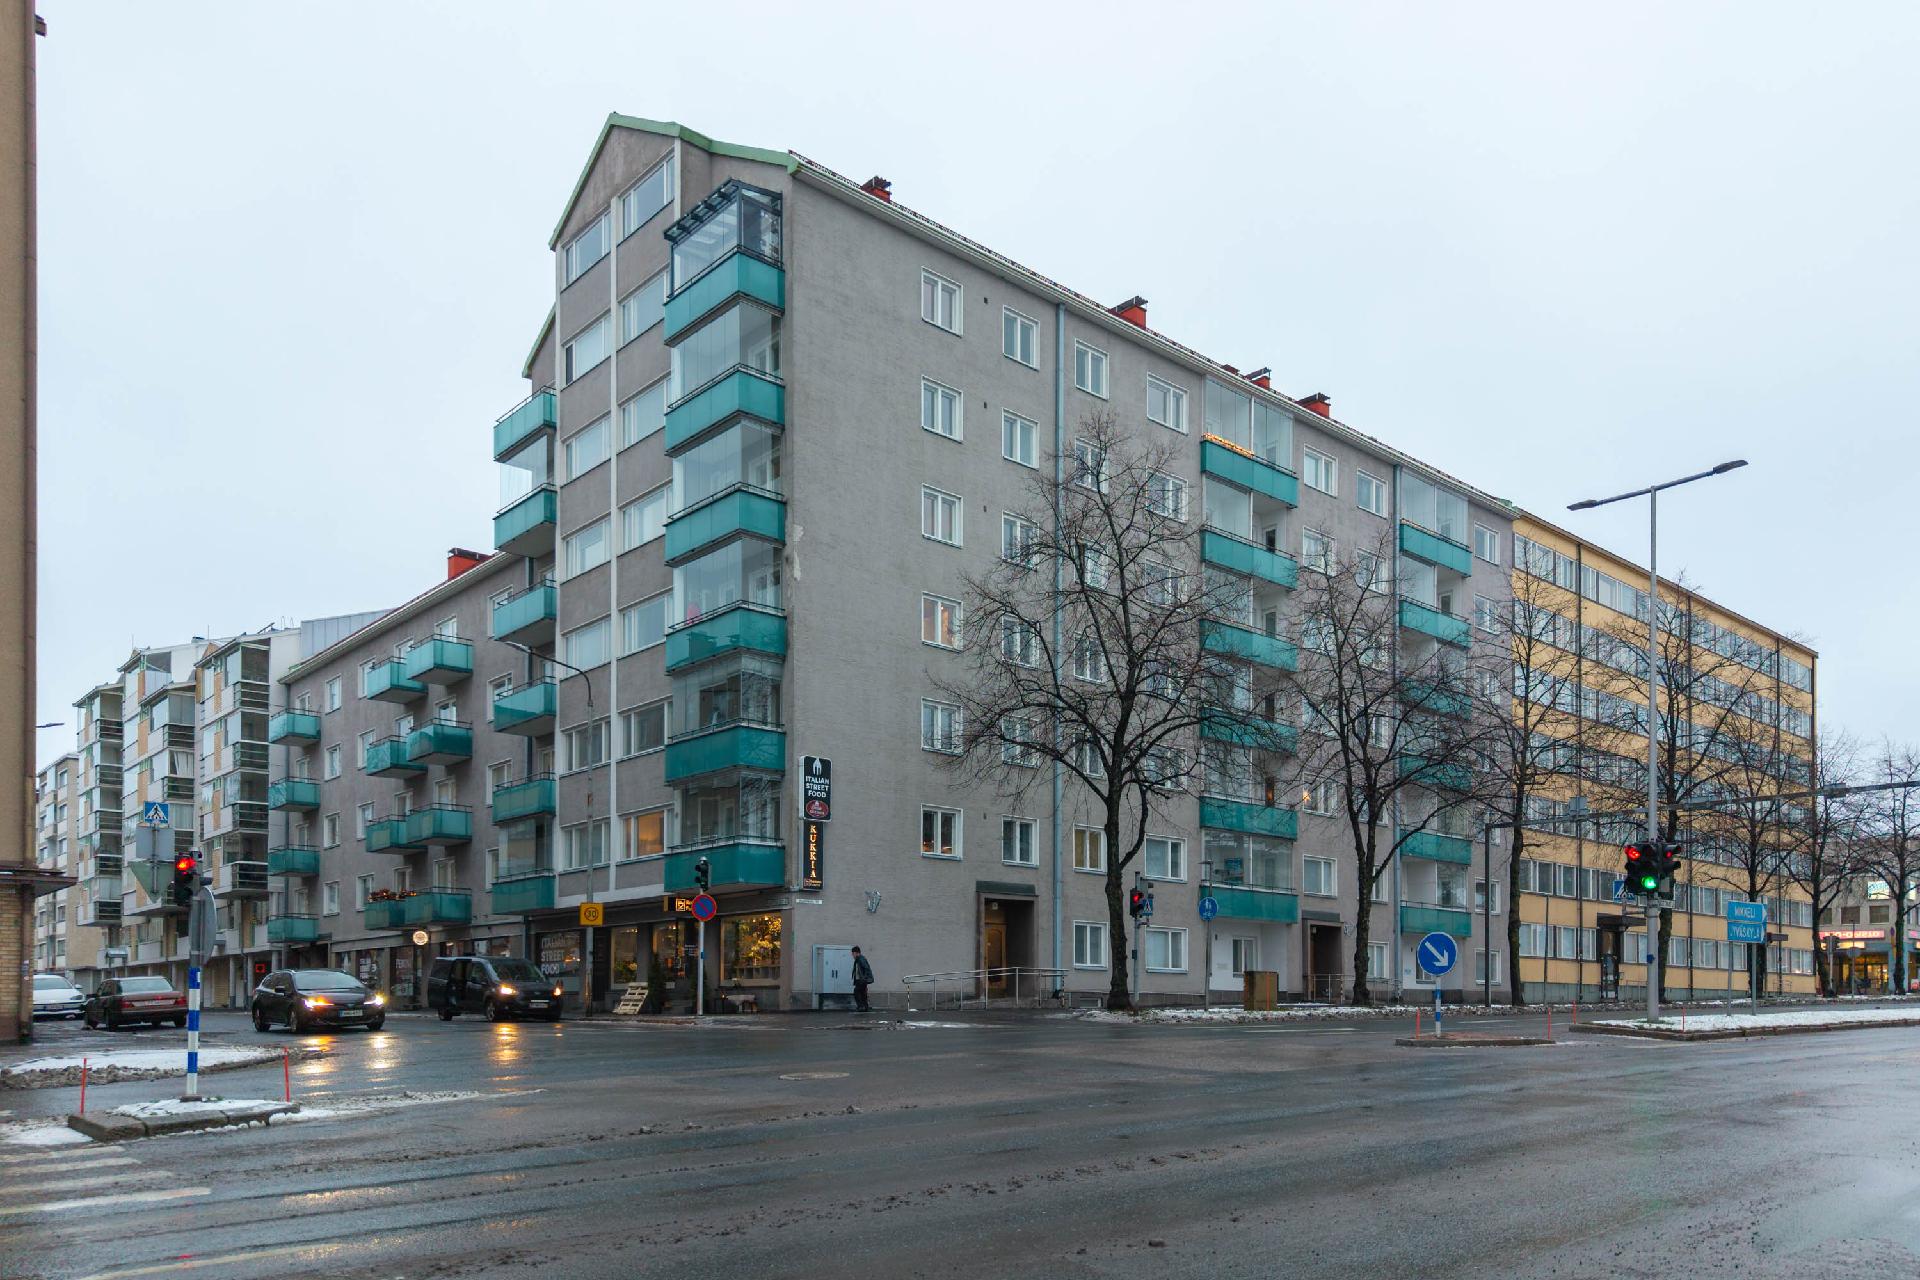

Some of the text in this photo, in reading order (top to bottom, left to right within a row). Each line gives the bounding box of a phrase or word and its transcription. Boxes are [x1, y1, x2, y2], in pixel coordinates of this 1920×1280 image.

[805, 776, 830, 785] ITALIAN
[805, 783, 830, 791] STREET
[808, 790, 827, 798] FOOD
[809, 825, 817, 878] KUKKIA
[587, 910, 597, 918] 30
[541, 950, 564, 962] STREET
[541, 963, 560, 974] FOOD
